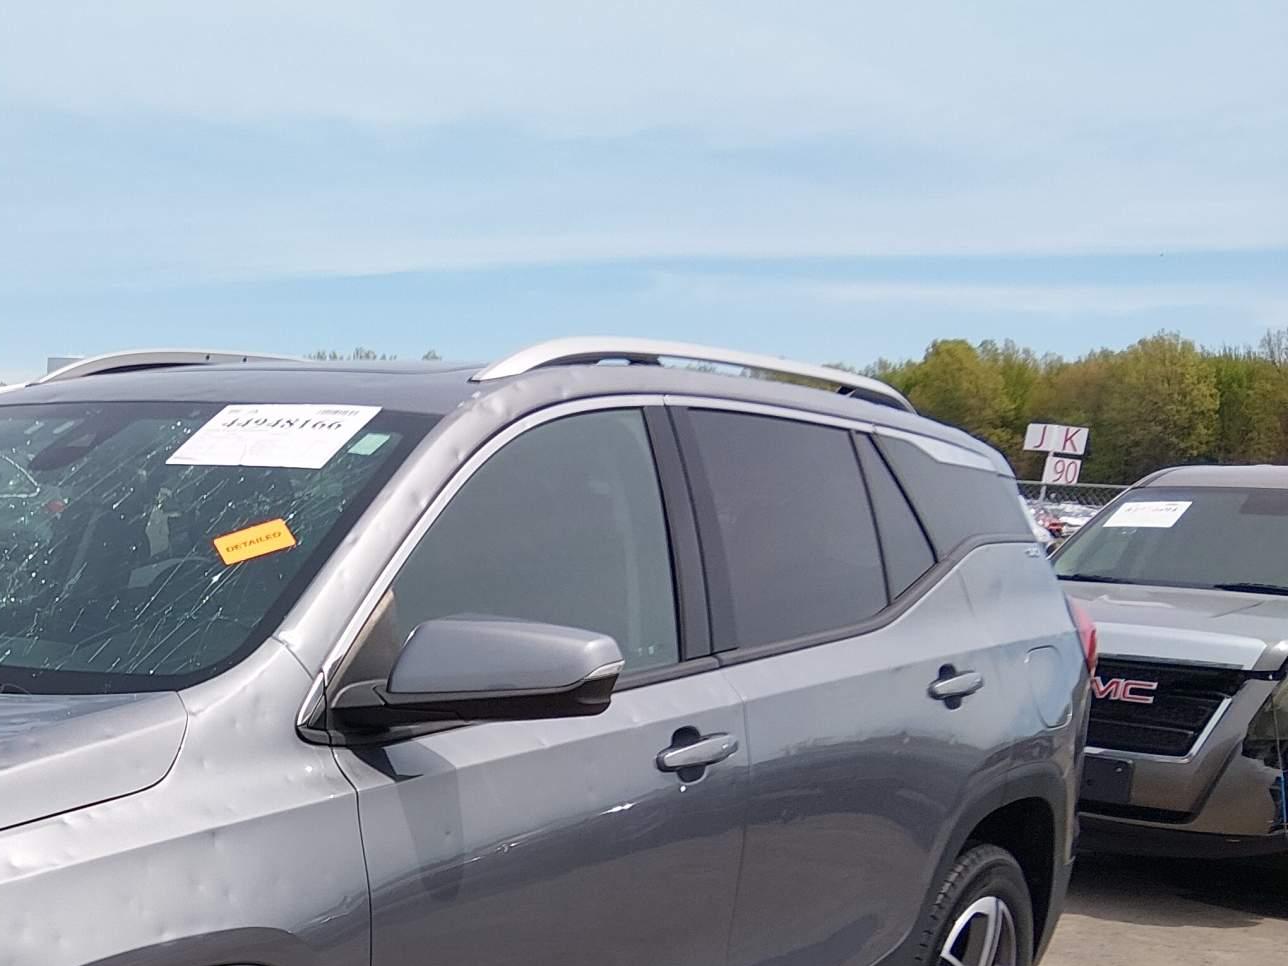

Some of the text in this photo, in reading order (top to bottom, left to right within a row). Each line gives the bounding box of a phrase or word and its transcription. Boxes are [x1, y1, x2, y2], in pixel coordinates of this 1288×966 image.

[1033, 425, 1081, 452] J K
[1051, 459, 1078, 485] 90
[225, 531, 282, 553] DETAILED
[1091, 676, 1159, 704] MC
